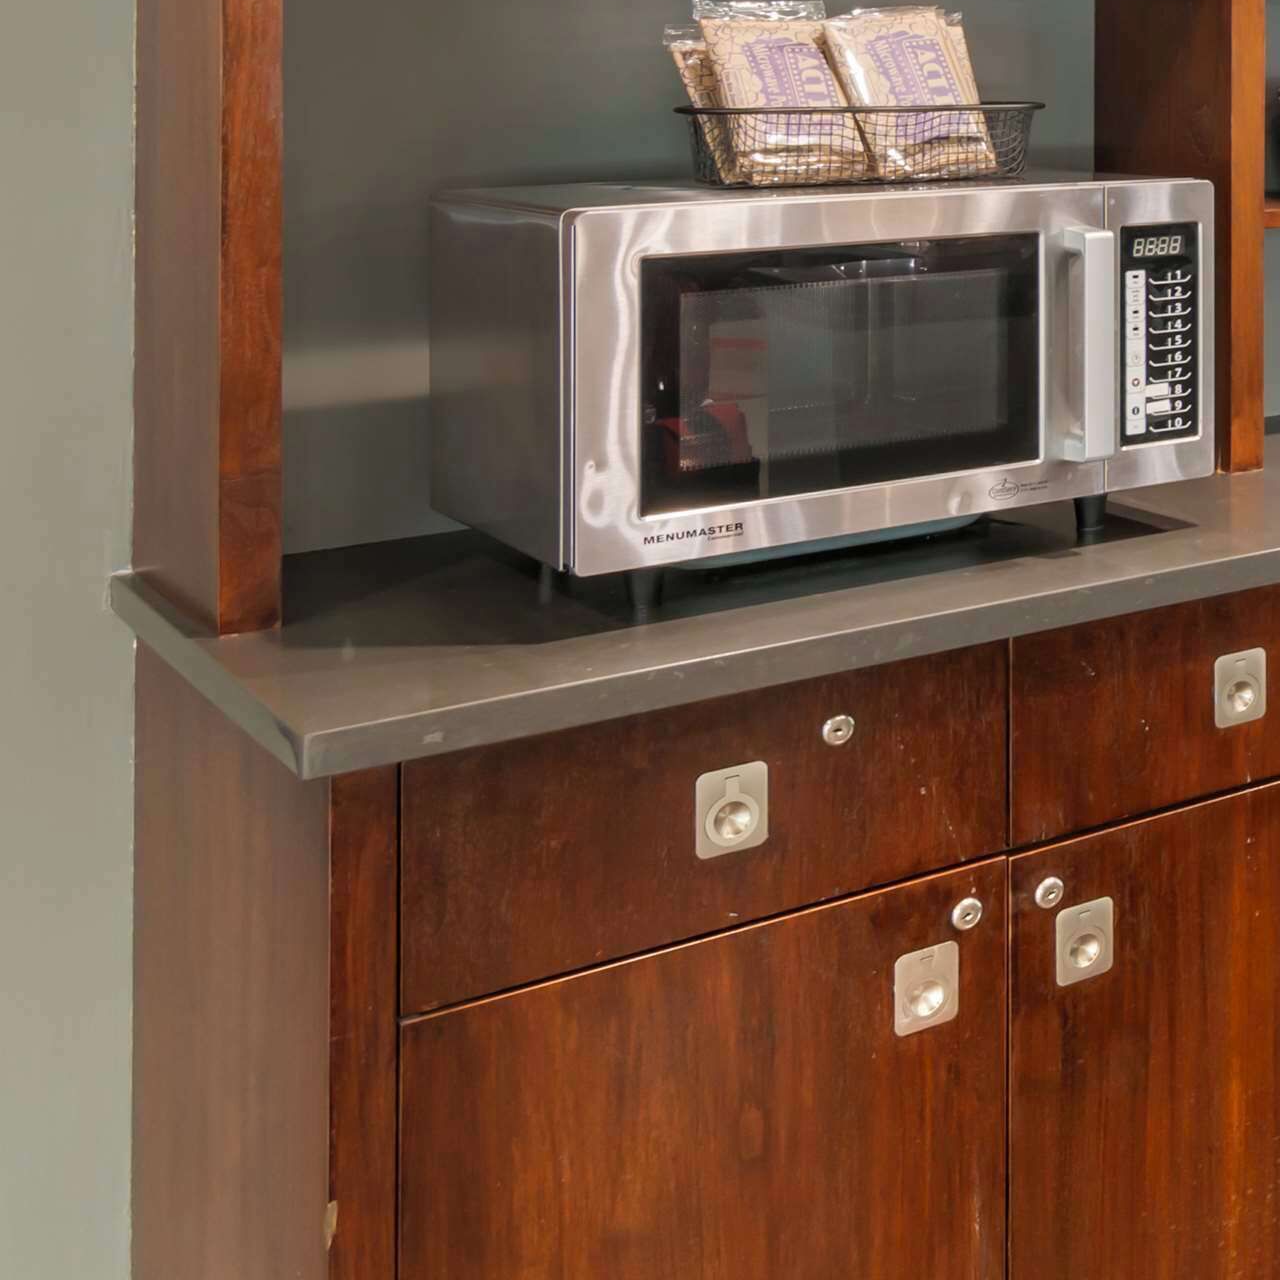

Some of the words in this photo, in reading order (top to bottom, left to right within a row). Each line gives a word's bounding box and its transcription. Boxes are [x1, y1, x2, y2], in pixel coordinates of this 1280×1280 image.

[797, 52, 829, 96] ACT
[914, 49, 952, 96] ACT
[1175, 270, 1181, 280] 1
[1174, 286, 1182, 297] 2
[1174, 303, 1182, 313] 3
[1174, 319, 1182, 329] 4
[1174, 334, 1182, 345] 5
[1174, 351, 1182, 361] 6
[1174, 367, 1182, 378] 7
[1174, 384, 1182, 394] 8
[1174, 400, 1182, 411] 9
[1174, 417, 1182, 428] 0
[643, 522, 744, 545] MENUMASTER
